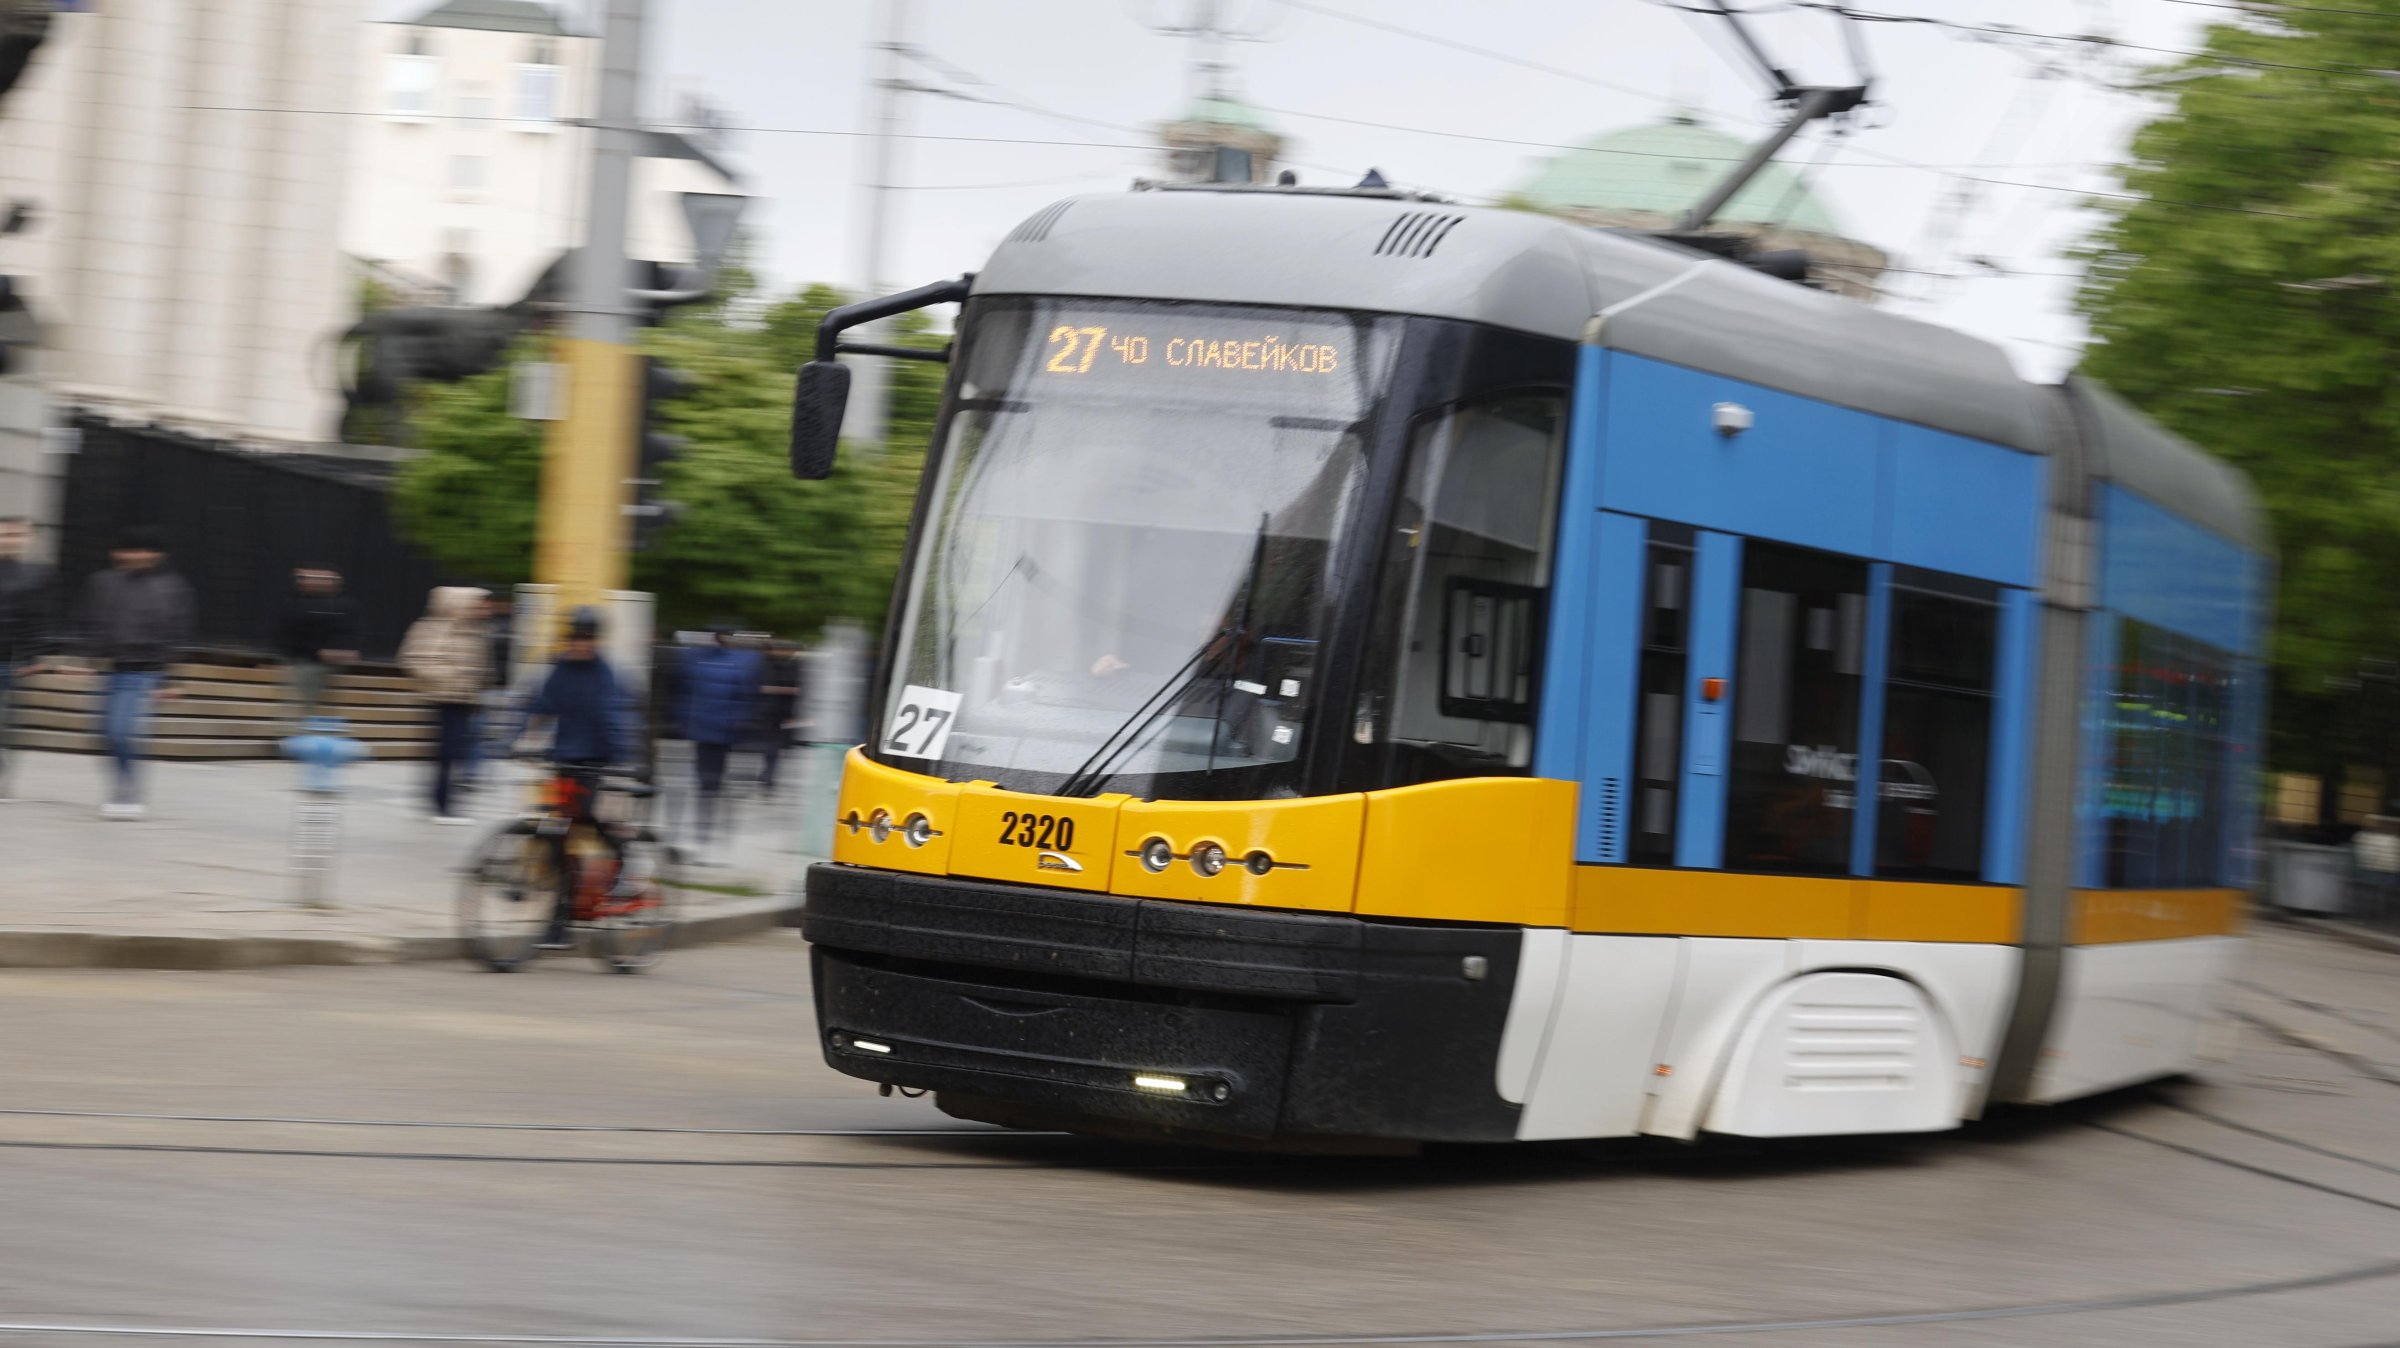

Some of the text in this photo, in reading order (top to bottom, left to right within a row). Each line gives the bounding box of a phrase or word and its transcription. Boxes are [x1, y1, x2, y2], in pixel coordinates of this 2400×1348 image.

[1047, 325, 1338, 373] 27 ЧО СЛАВЕЙКОВ
[889, 703, 951, 754] 27
[999, 811, 1074, 851] 2320
